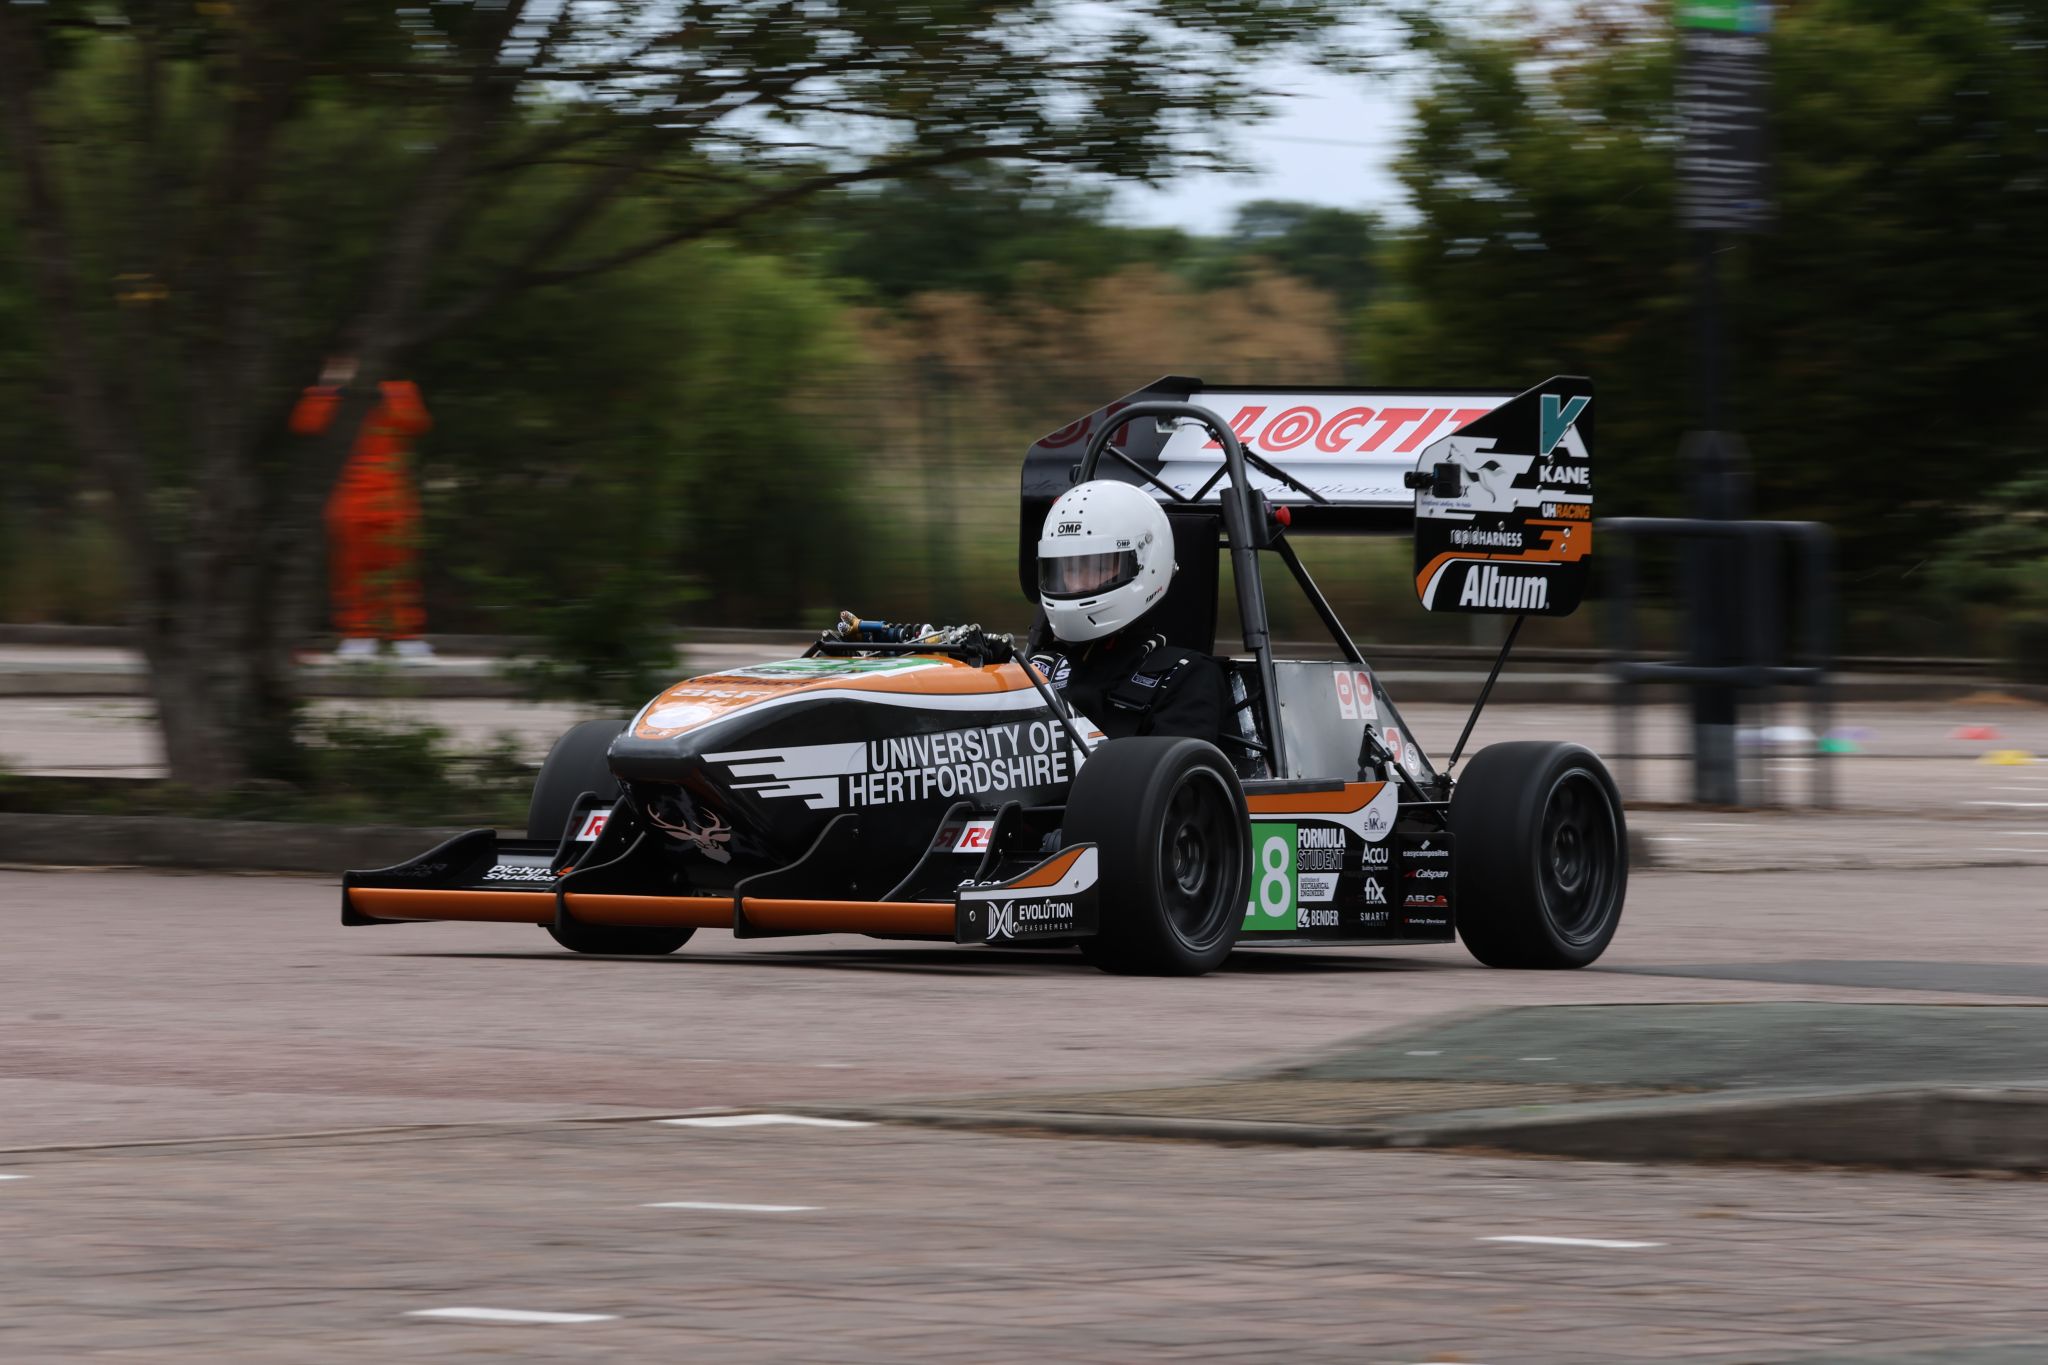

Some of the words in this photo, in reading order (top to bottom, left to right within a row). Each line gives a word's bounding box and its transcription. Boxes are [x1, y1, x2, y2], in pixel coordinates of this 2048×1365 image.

[1202, 406, 1495, 453] LOCTIT
[1540, 465, 1589, 484] KANE
[1542, 502, 1590, 519] UHRACING
[1058, 523, 1081, 534] OMP
[1450, 526, 1522, 549] rapidHARNESS
[1459, 565, 1548, 609] Altium
[871, 725, 1019, 772] UNIVERSITY
[1029, 719, 1065, 753] OF
[849, 752, 1068, 807] HERTFORDSHIRE
[584, 816, 608, 836] R
[1297, 828, 1346, 848] FORMULA
[1297, 849, 1344, 870] STUDENT
[1403, 850, 1448, 858] easycomposites
[483, 873, 557, 882] Studios
[1246, 836, 1291, 917] 8
[1416, 869, 1448, 879] Calspan
[1019, 903, 1073, 920] EVOLUTION
[1311, 910, 1339, 926] BENDER
[1360, 912, 1389, 921] SMARTY
[1019, 923, 1073, 932] MEASUREMENT
